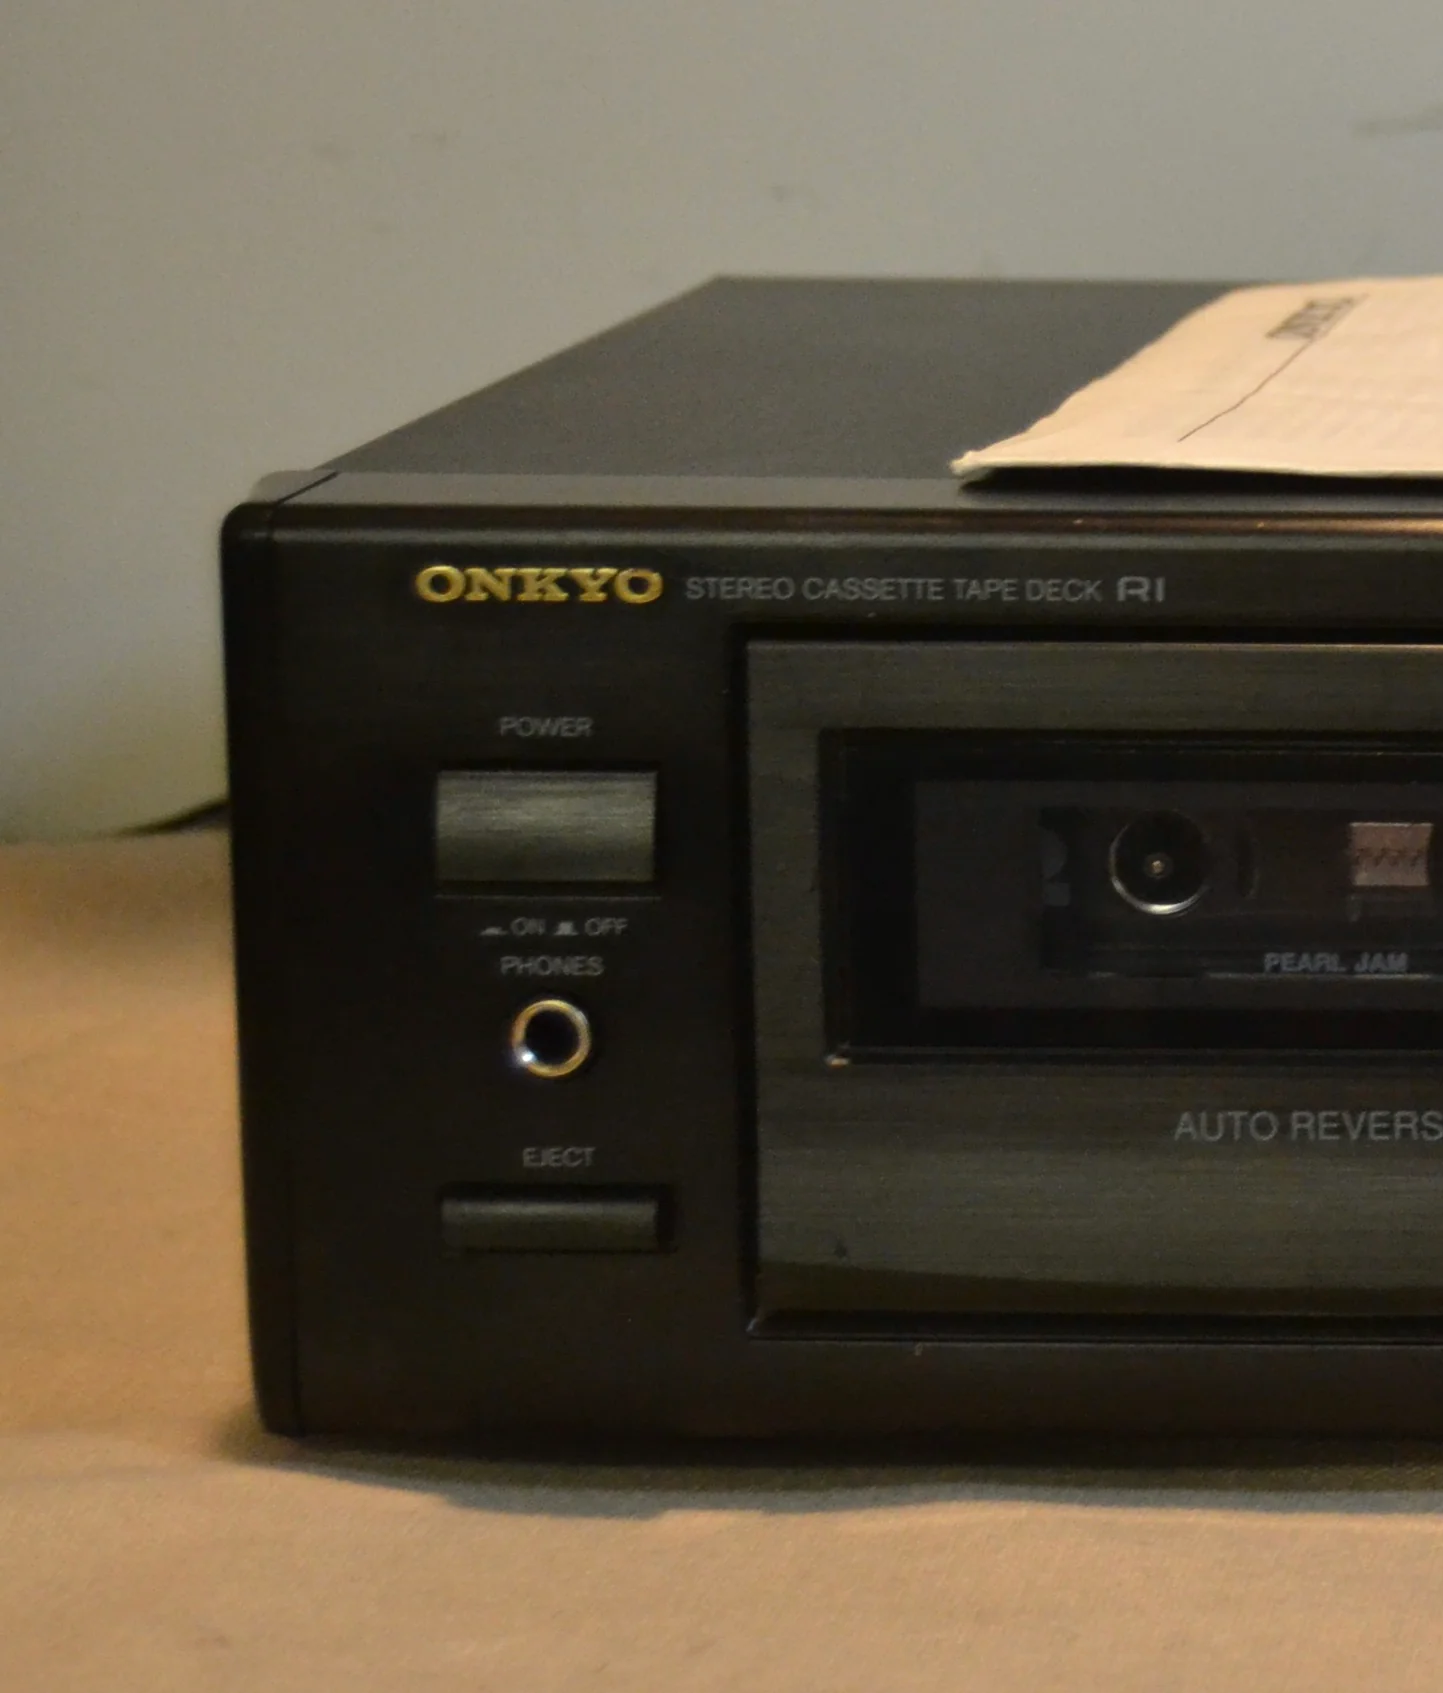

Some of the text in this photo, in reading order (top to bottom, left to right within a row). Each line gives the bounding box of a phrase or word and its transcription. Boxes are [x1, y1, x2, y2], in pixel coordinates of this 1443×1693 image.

[415, 564, 663, 604] ONKYO
[685, 576, 796, 601] STEREO
[801, 576, 945, 601] CASSETTE
[952, 577, 1019, 602] TAPE
[1025, 577, 1102, 603] DECK
[499, 715, 593, 738] POWER
[510, 916, 546, 937] ON
[583, 916, 628, 937] OFF
[500, 954, 604, 977] PHONES
[1263, 951, 1408, 973] PEARL JAM
[1173, 1110, 1279, 1143] AUTO
[521, 1145, 596, 1168] EJECT
